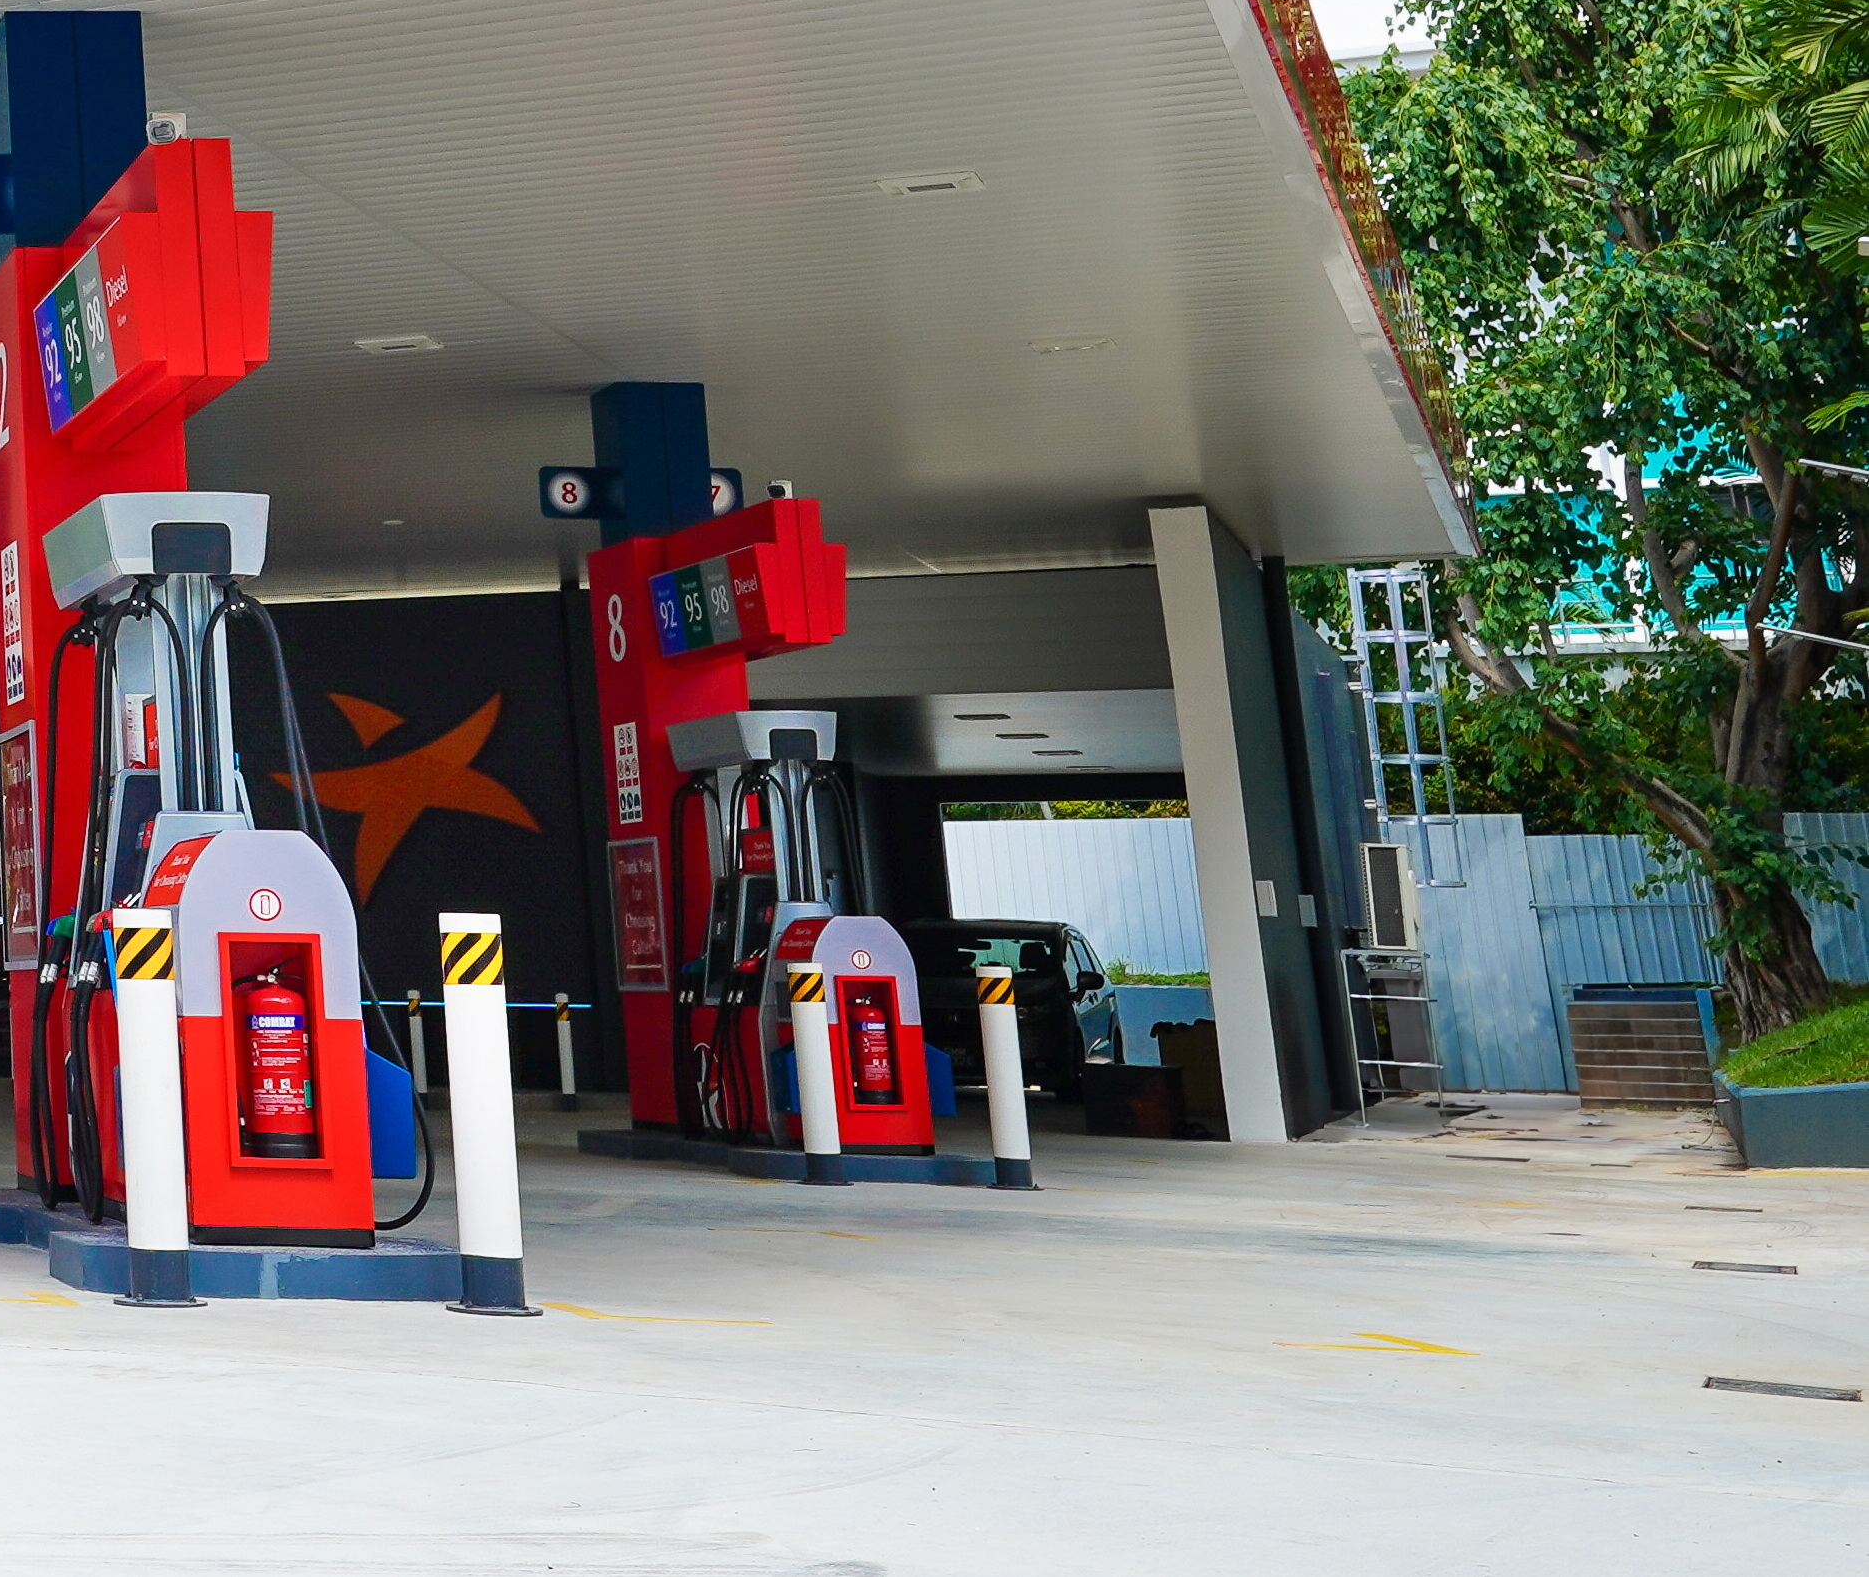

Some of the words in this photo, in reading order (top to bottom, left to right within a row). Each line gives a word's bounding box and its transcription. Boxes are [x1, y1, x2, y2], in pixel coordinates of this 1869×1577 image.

[105, 265, 129, 308] Diesel
[86, 295, 105, 349] 98
[65, 317, 82, 369] 95
[44, 339, 62, 389] 92
[562, 482, 578, 504] 8
[711, 585, 729, 616] 98
[734, 574, 758, 596] Diesel
[660, 600, 678, 630] 92
[685, 593, 703, 623] 95
[608, 594, 626, 662] 8
